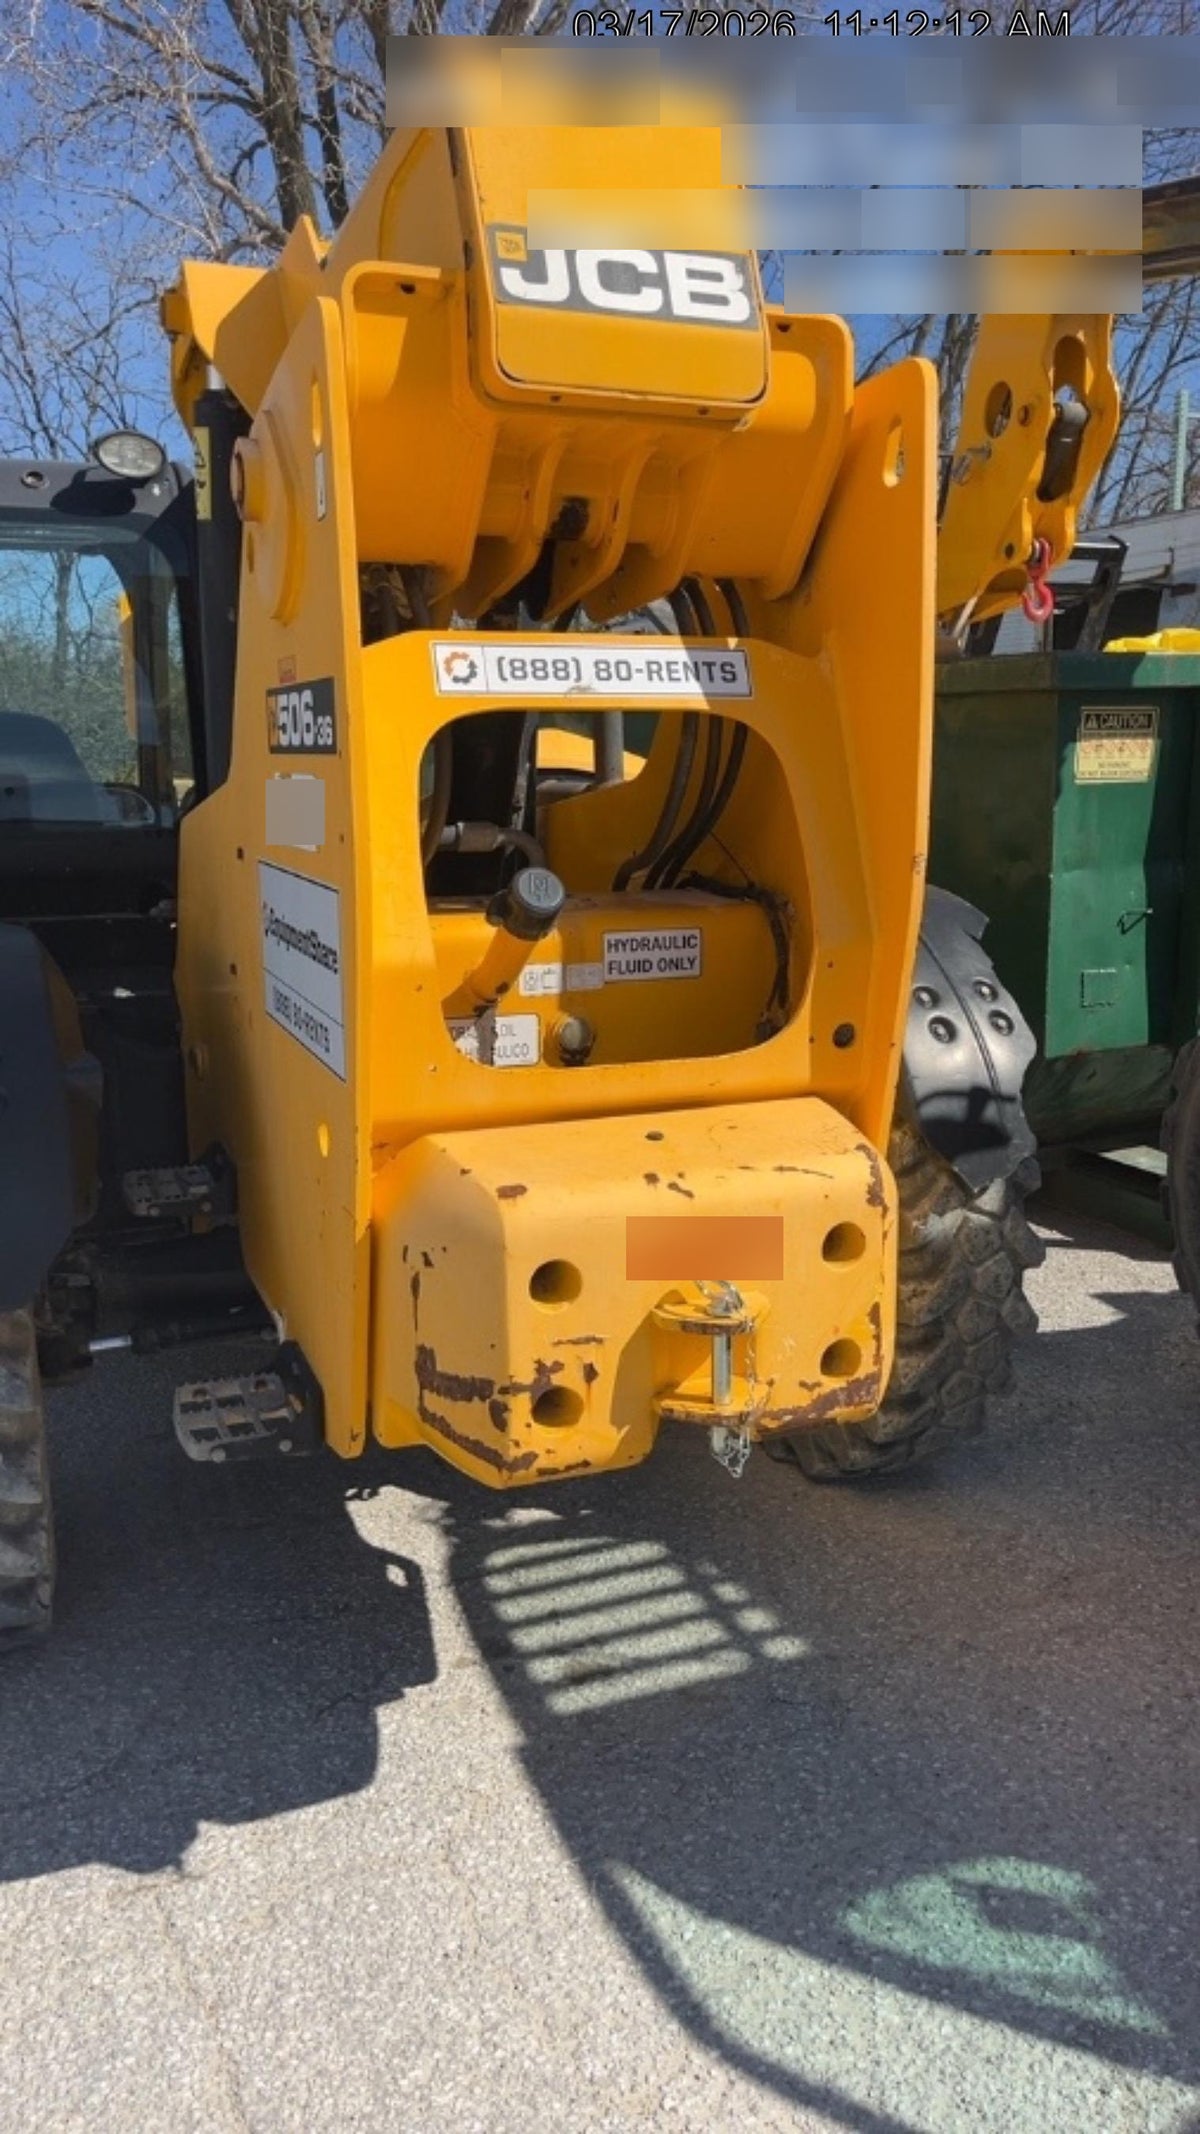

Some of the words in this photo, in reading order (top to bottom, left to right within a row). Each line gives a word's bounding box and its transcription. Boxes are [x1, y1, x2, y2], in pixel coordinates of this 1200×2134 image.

[500, 250, 750, 323] JCB
[497, 656, 583, 683] (888)
[594, 658, 738, 684] 80-RENTS
[607, 934, 698, 953] HYDRAULIC
[608, 958, 653, 976] FLUID
[657, 956, 697, 973] ONLY
